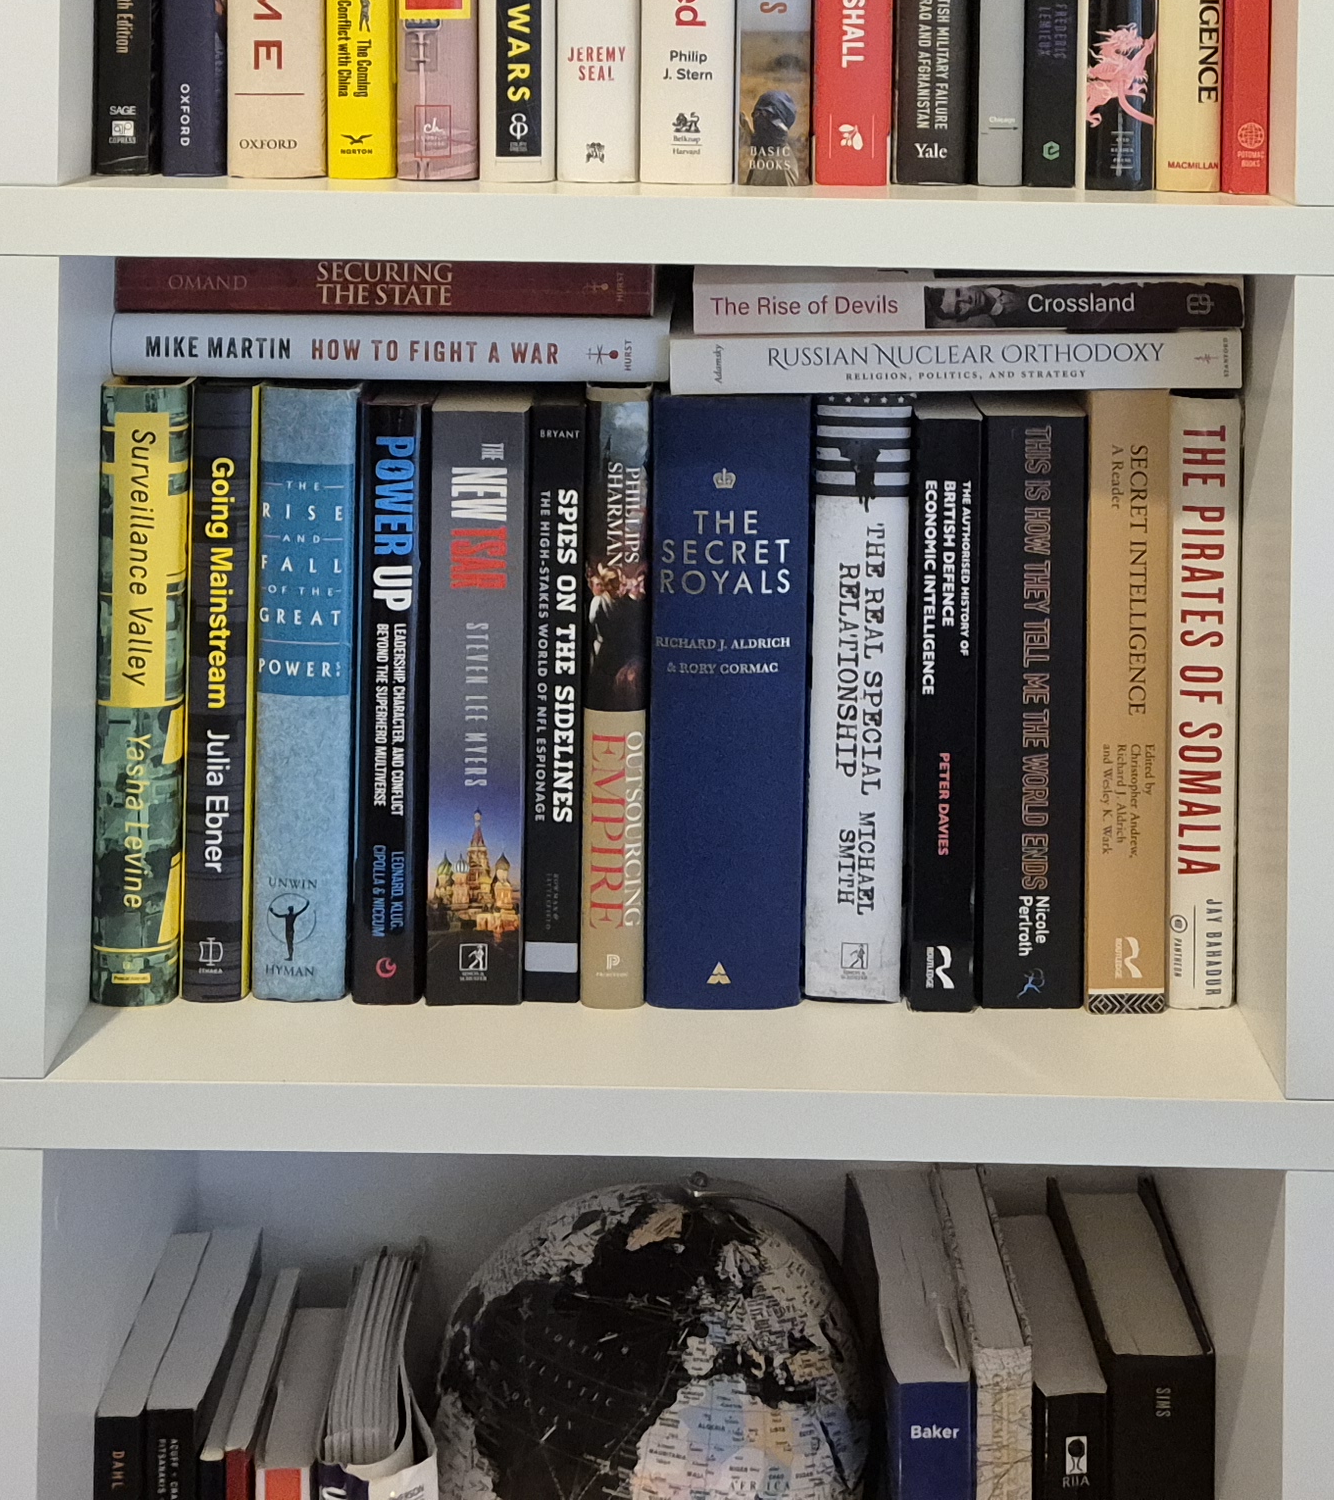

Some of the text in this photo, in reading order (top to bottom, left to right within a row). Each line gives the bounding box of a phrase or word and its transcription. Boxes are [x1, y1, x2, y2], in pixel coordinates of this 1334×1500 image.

[568, 47, 625, 62] JEREMY
[579, 65, 613, 81] SEAL
[915, 143, 947, 158] Yale
[318, 263, 452, 282] SECURING
[317, 284, 451, 305] THE STATE
[1028, 293, 1134, 312] Crossland
[710, 295, 898, 315] The Rise of Devils
[146, 336, 290, 359] MIKE MARTIN
[540, 430, 579, 438] BRYANT
[694, 512, 757, 534] THE
[663, 539, 790, 564] SECRET
[662, 569, 790, 594] ROYALS
[269, 877, 317, 889] UNWIN
[266, 964, 315, 976] HYMAN
[911, 1425, 959, 1439] Baker
